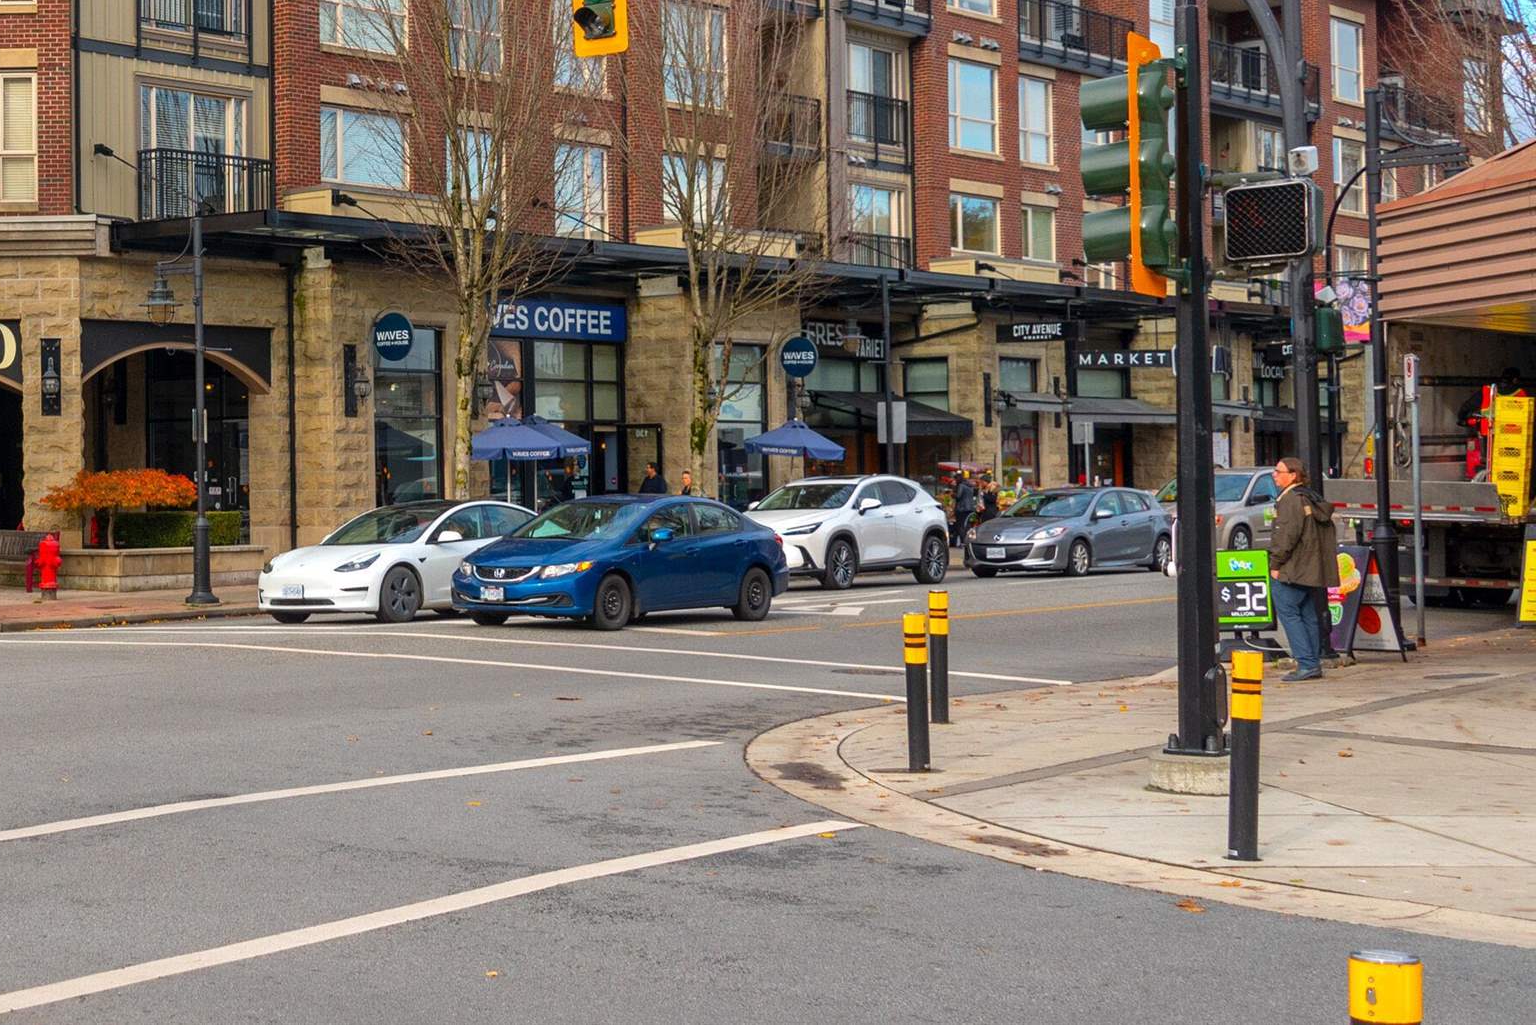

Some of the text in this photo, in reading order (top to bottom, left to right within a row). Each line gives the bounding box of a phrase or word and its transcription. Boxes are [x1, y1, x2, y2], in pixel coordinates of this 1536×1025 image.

[493, 303, 612, 335] VES COFFEE
[376, 329, 409, 341] WAVES
[807, 321, 844, 347] FRES
[1013, 323, 1062, 337] CITY AVENUE
[783, 351, 814, 360] WAVES
[856, 338, 884, 359] VARIET
[1079, 352, 1167, 366] MARKET
[1261, 365, 1284, 378] LOCAL
